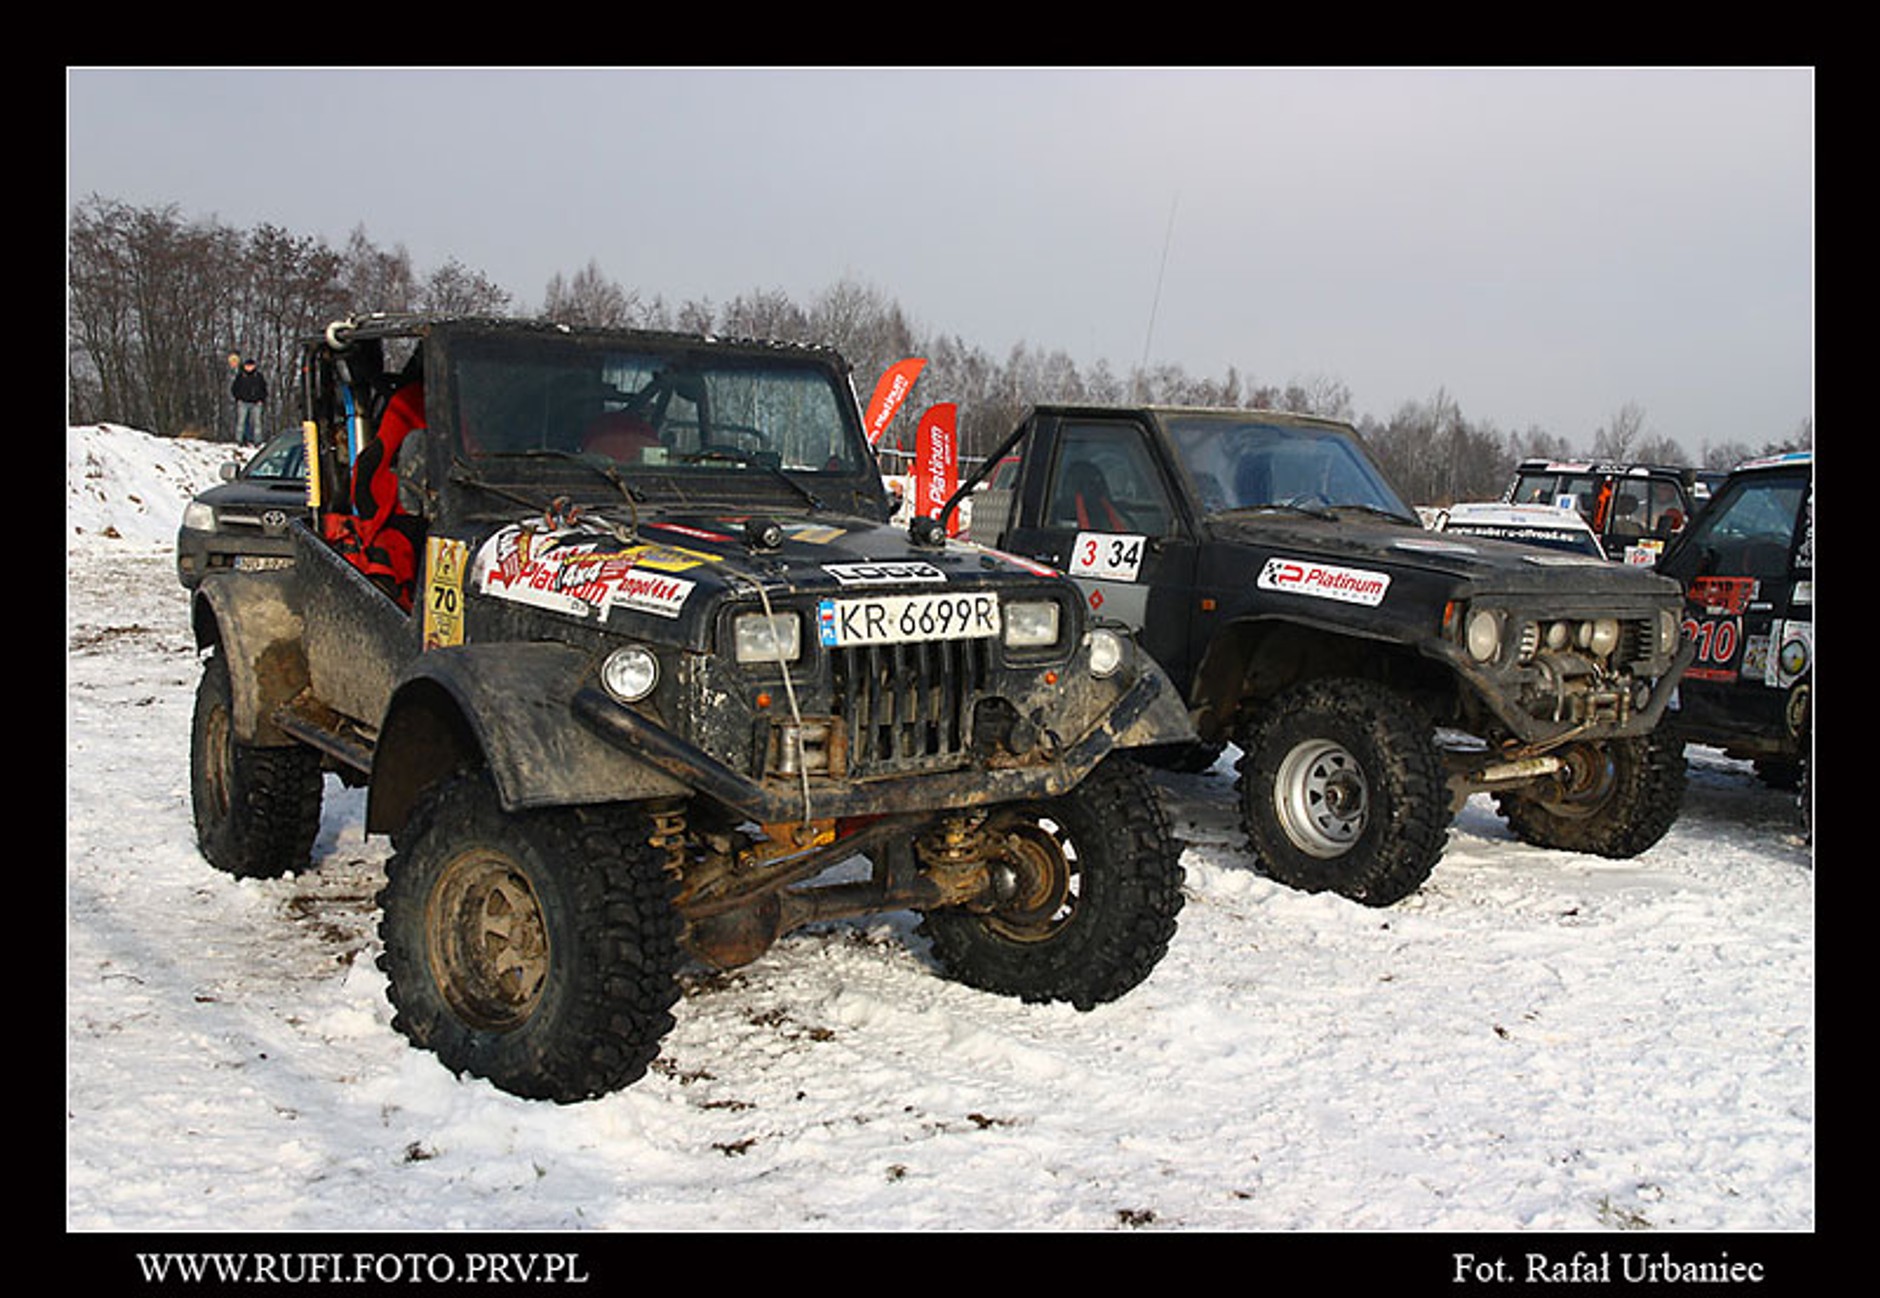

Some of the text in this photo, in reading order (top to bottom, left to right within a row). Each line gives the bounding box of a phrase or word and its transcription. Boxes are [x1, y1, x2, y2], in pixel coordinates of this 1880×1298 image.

[928, 425, 945, 504] Platinum
[1081, 540, 1140, 569] 3 34
[1304, 568, 1383, 595] Platinum
[434, 586, 457, 612] 70
[840, 597, 994, 641] KR 6699R
